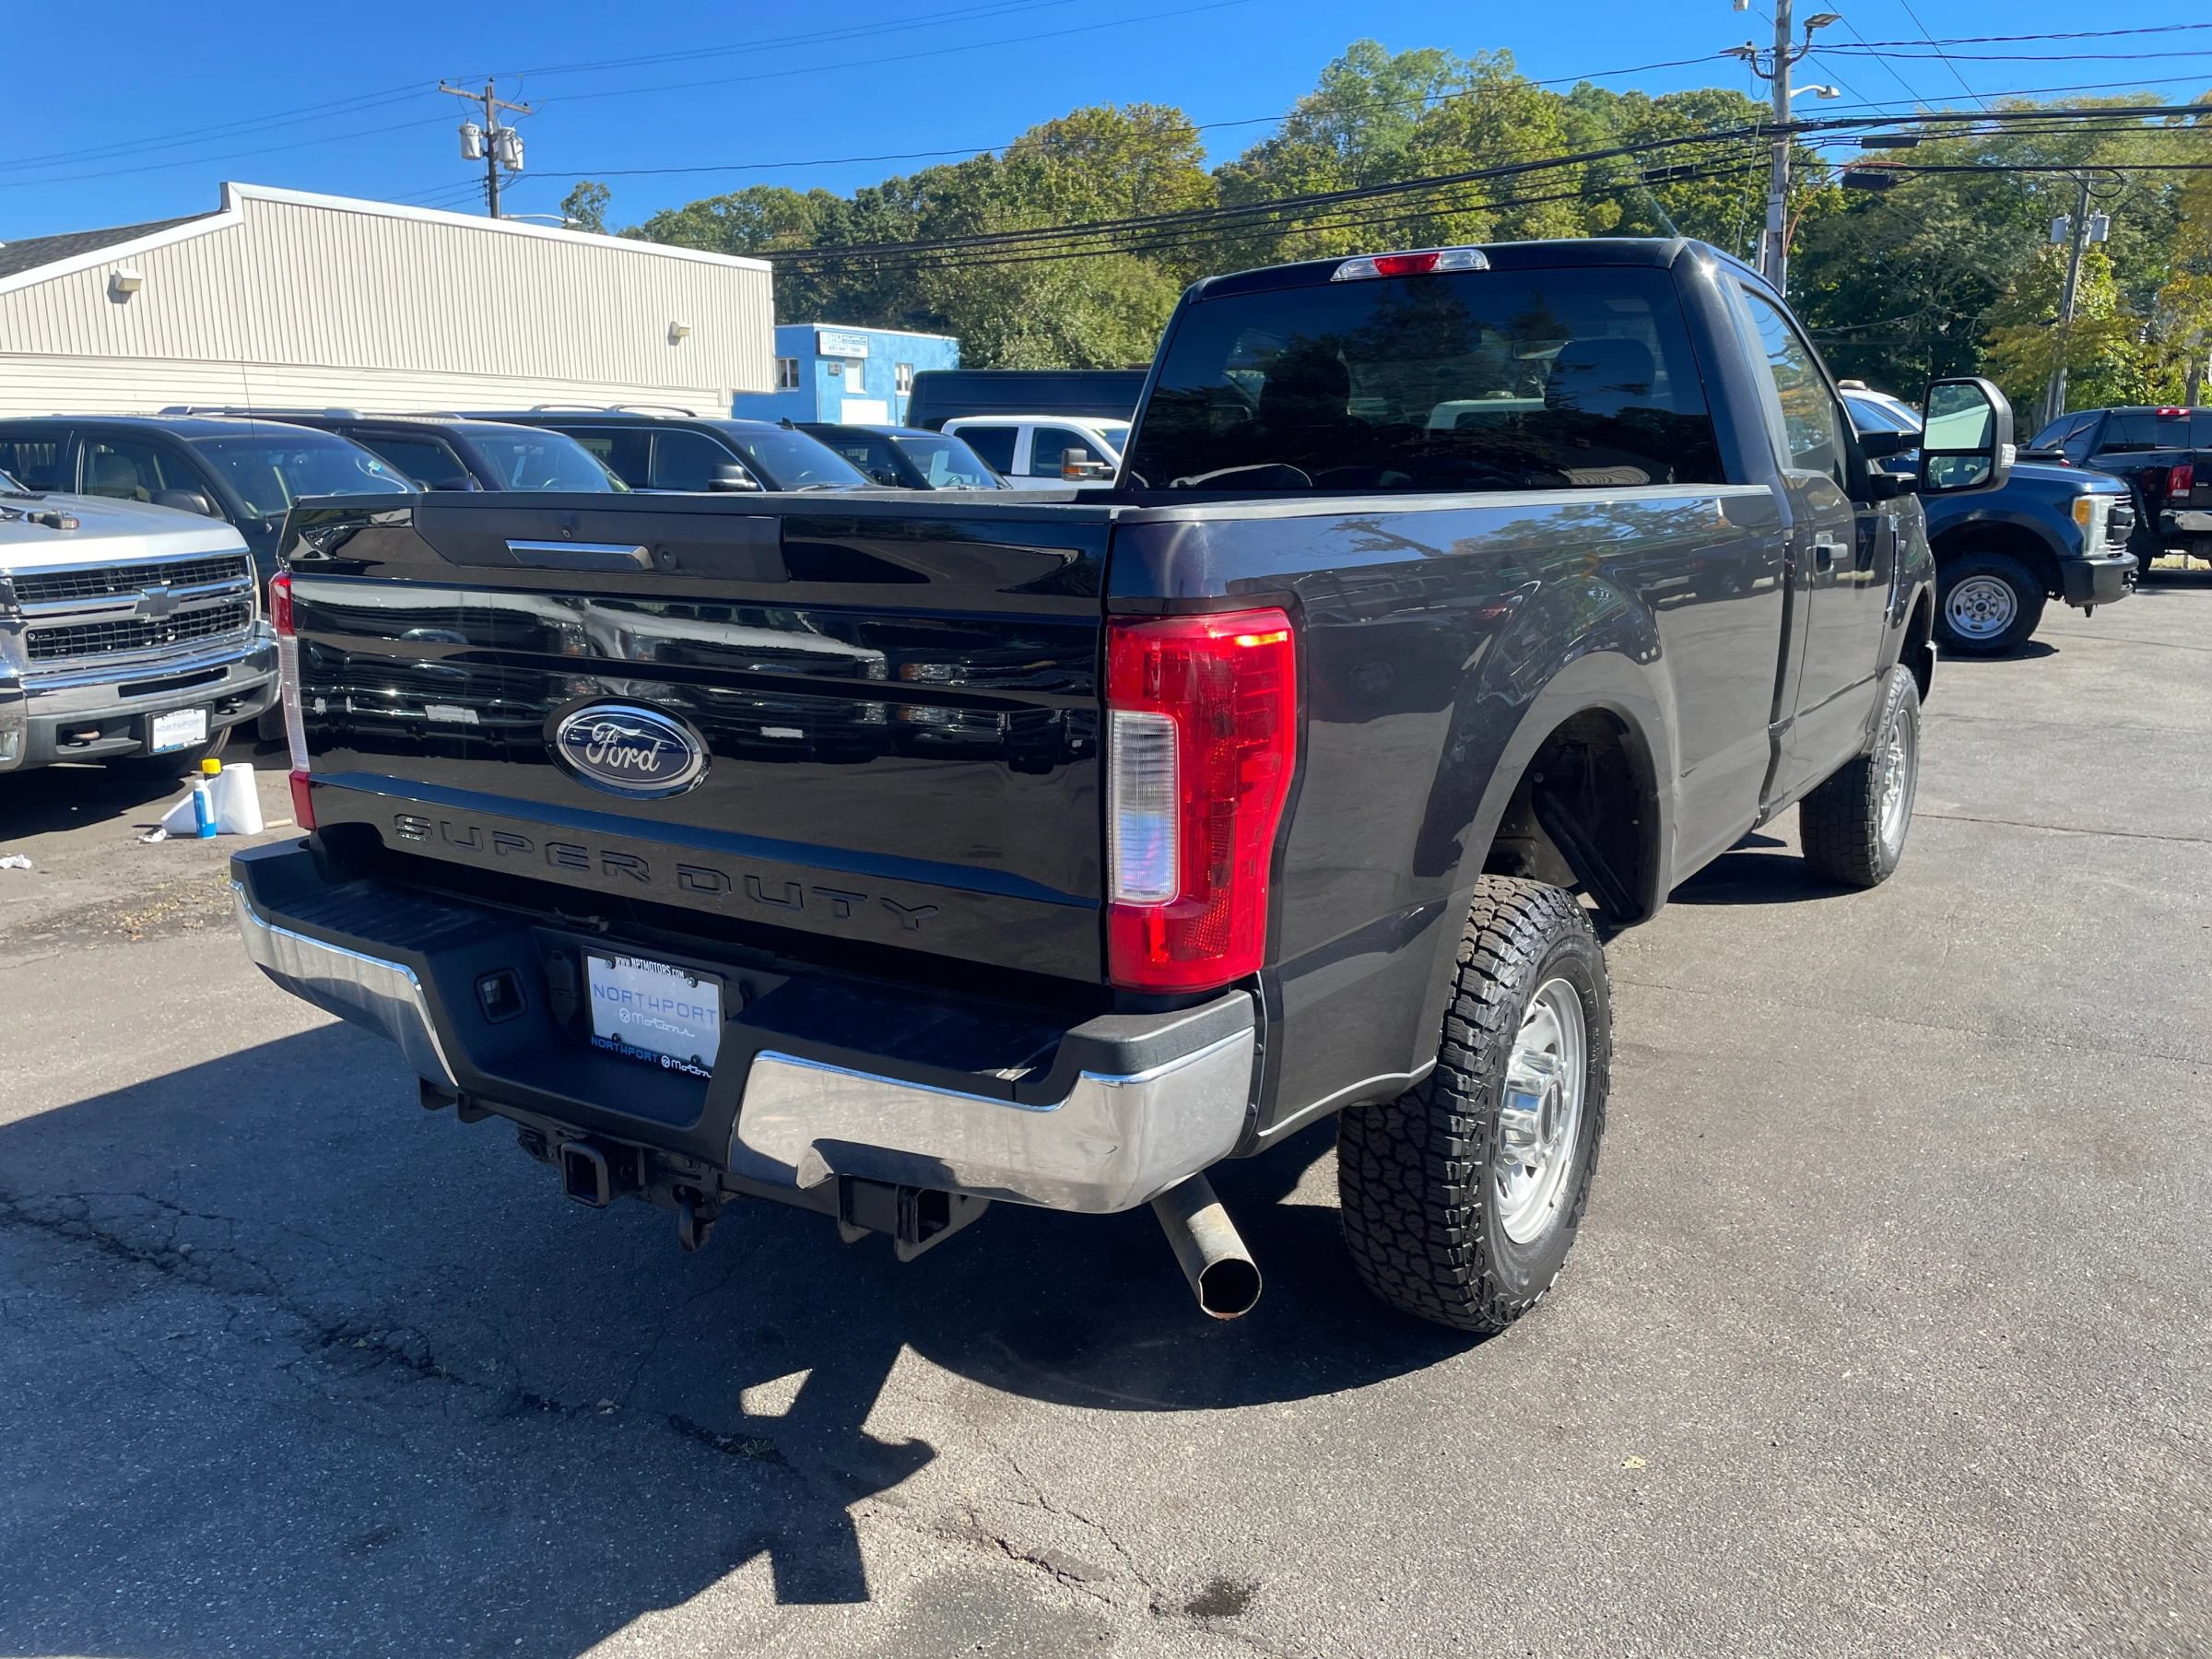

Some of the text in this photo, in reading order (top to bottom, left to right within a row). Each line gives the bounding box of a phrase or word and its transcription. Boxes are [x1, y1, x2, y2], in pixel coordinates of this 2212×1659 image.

[585, 722, 661, 772] Ford
[393, 813, 938, 930] SUPER DUTY
[593, 982, 717, 1026] NORTHPORT
[591, 1036, 659, 1064] NORTHPORT
